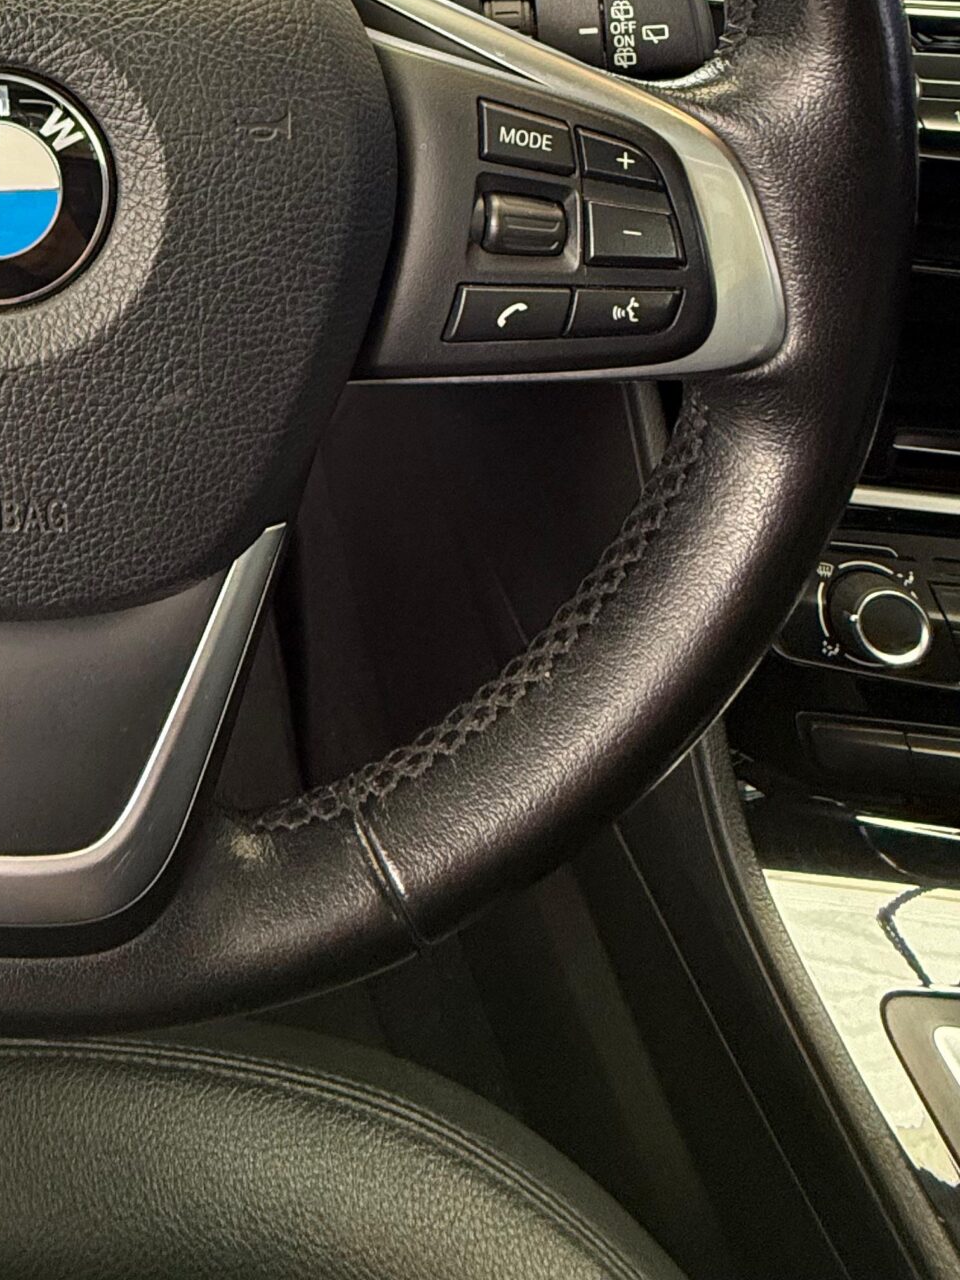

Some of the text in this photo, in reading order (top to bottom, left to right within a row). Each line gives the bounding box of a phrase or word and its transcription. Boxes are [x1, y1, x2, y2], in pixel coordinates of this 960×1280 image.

[610, 21, 637, 35] OFF
[613, 34, 635, 48] ON
[499, 126, 553, 152] MODE
